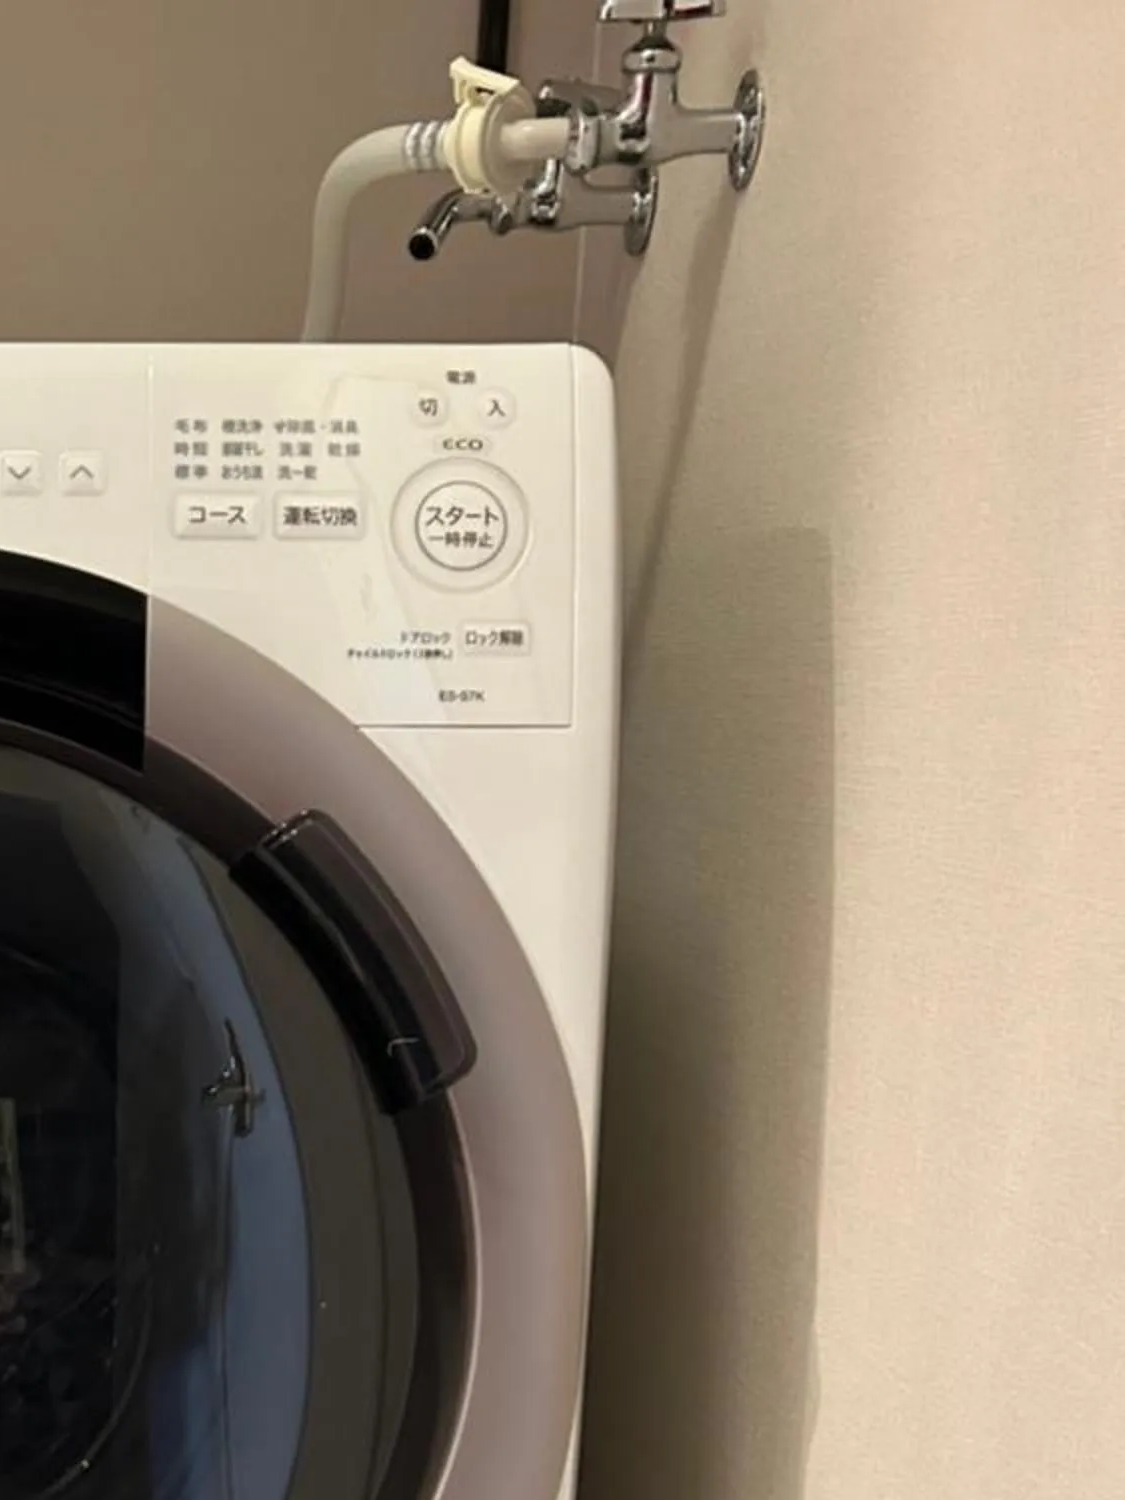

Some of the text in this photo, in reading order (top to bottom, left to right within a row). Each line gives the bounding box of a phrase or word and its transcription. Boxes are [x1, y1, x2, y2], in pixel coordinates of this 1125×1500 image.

[446, 370, 476, 384] 電源
[419, 398, 438, 416] 切
[487, 399, 506, 417] 入
[188, 505, 246, 524] コース
[283, 505, 358, 526] 運転切換
[426, 505, 499, 527] スタート
[429, 531, 494, 548] 一時停止
